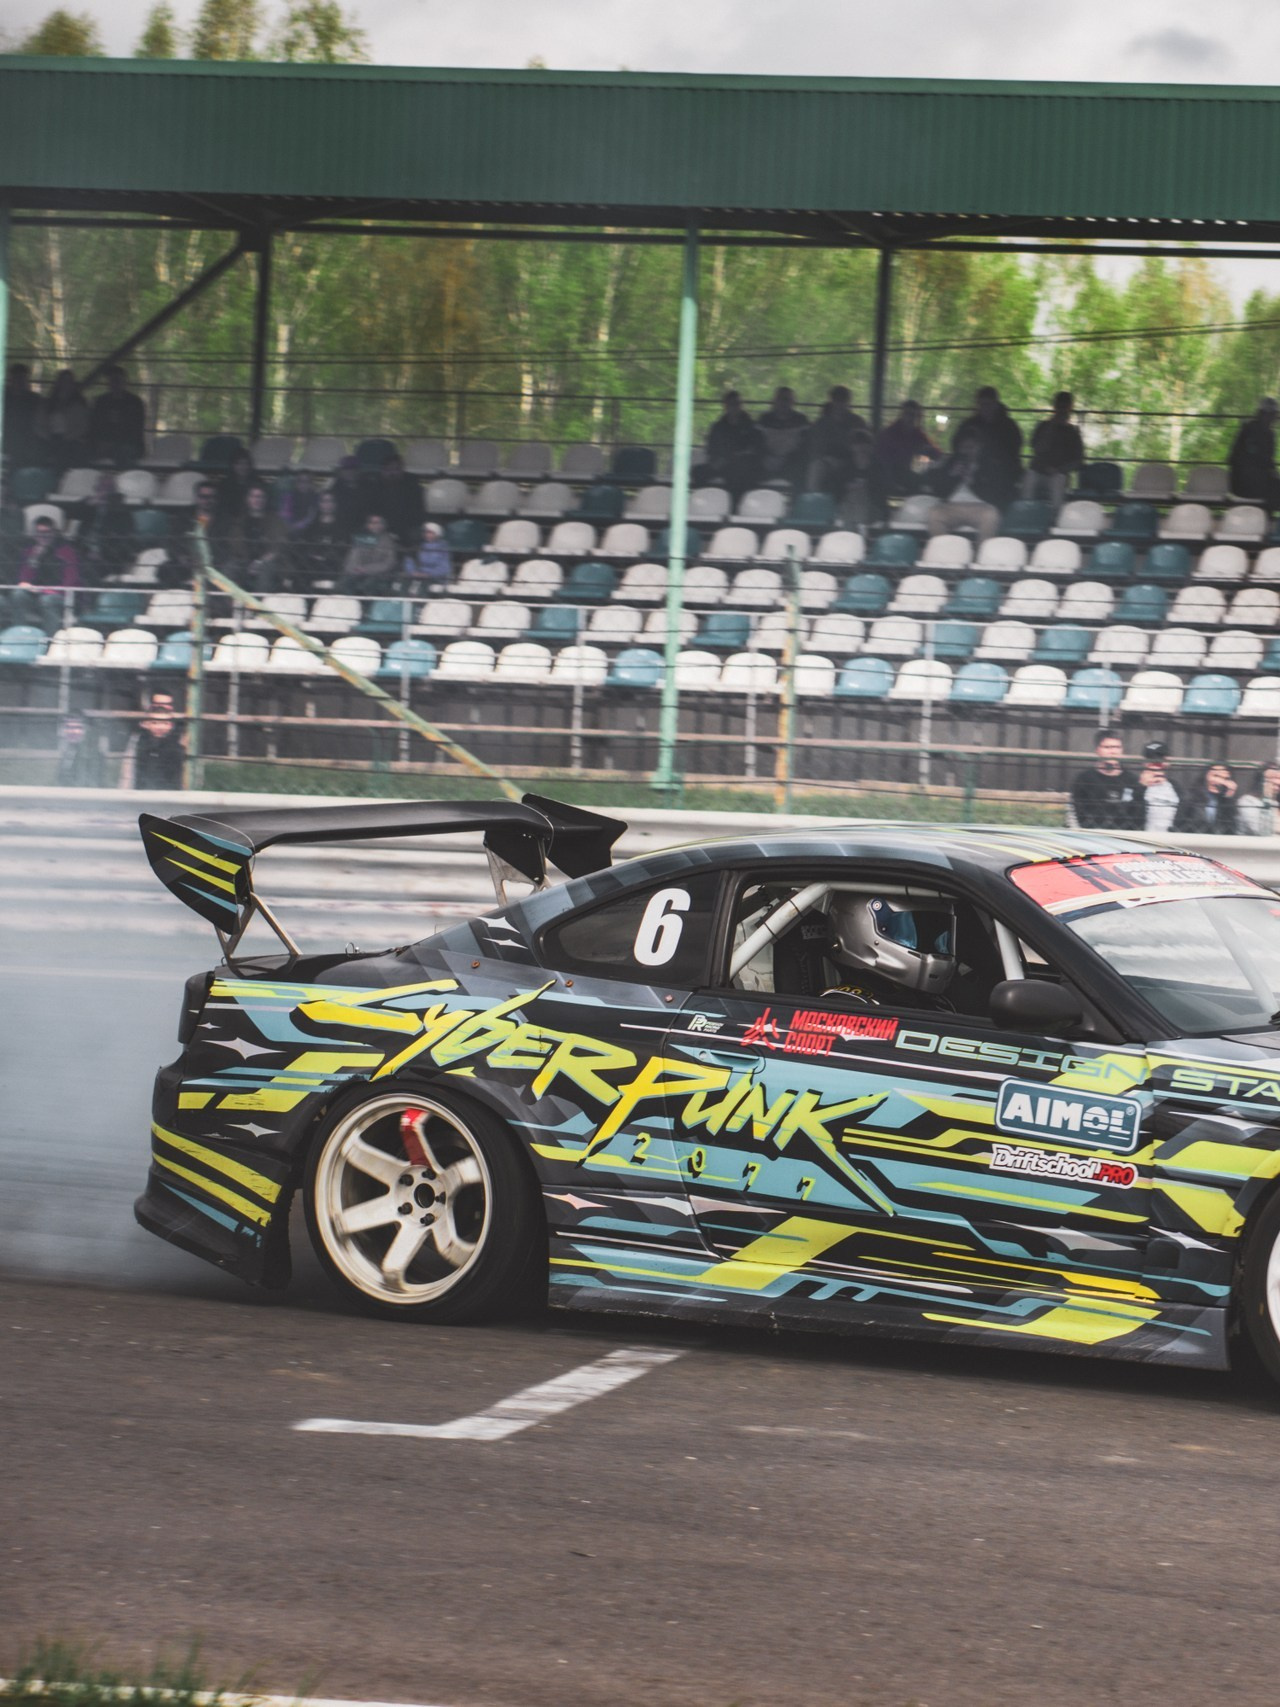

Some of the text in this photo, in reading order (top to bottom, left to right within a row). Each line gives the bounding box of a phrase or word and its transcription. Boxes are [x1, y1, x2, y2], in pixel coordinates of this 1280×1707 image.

[634, 888, 691, 966] 6
[784, 1032, 836, 1057] СПОРТ
[789, 1010, 899, 1040] МОСКОВСКИЙ
[895, 1029, 1148, 1085] DESIGN
